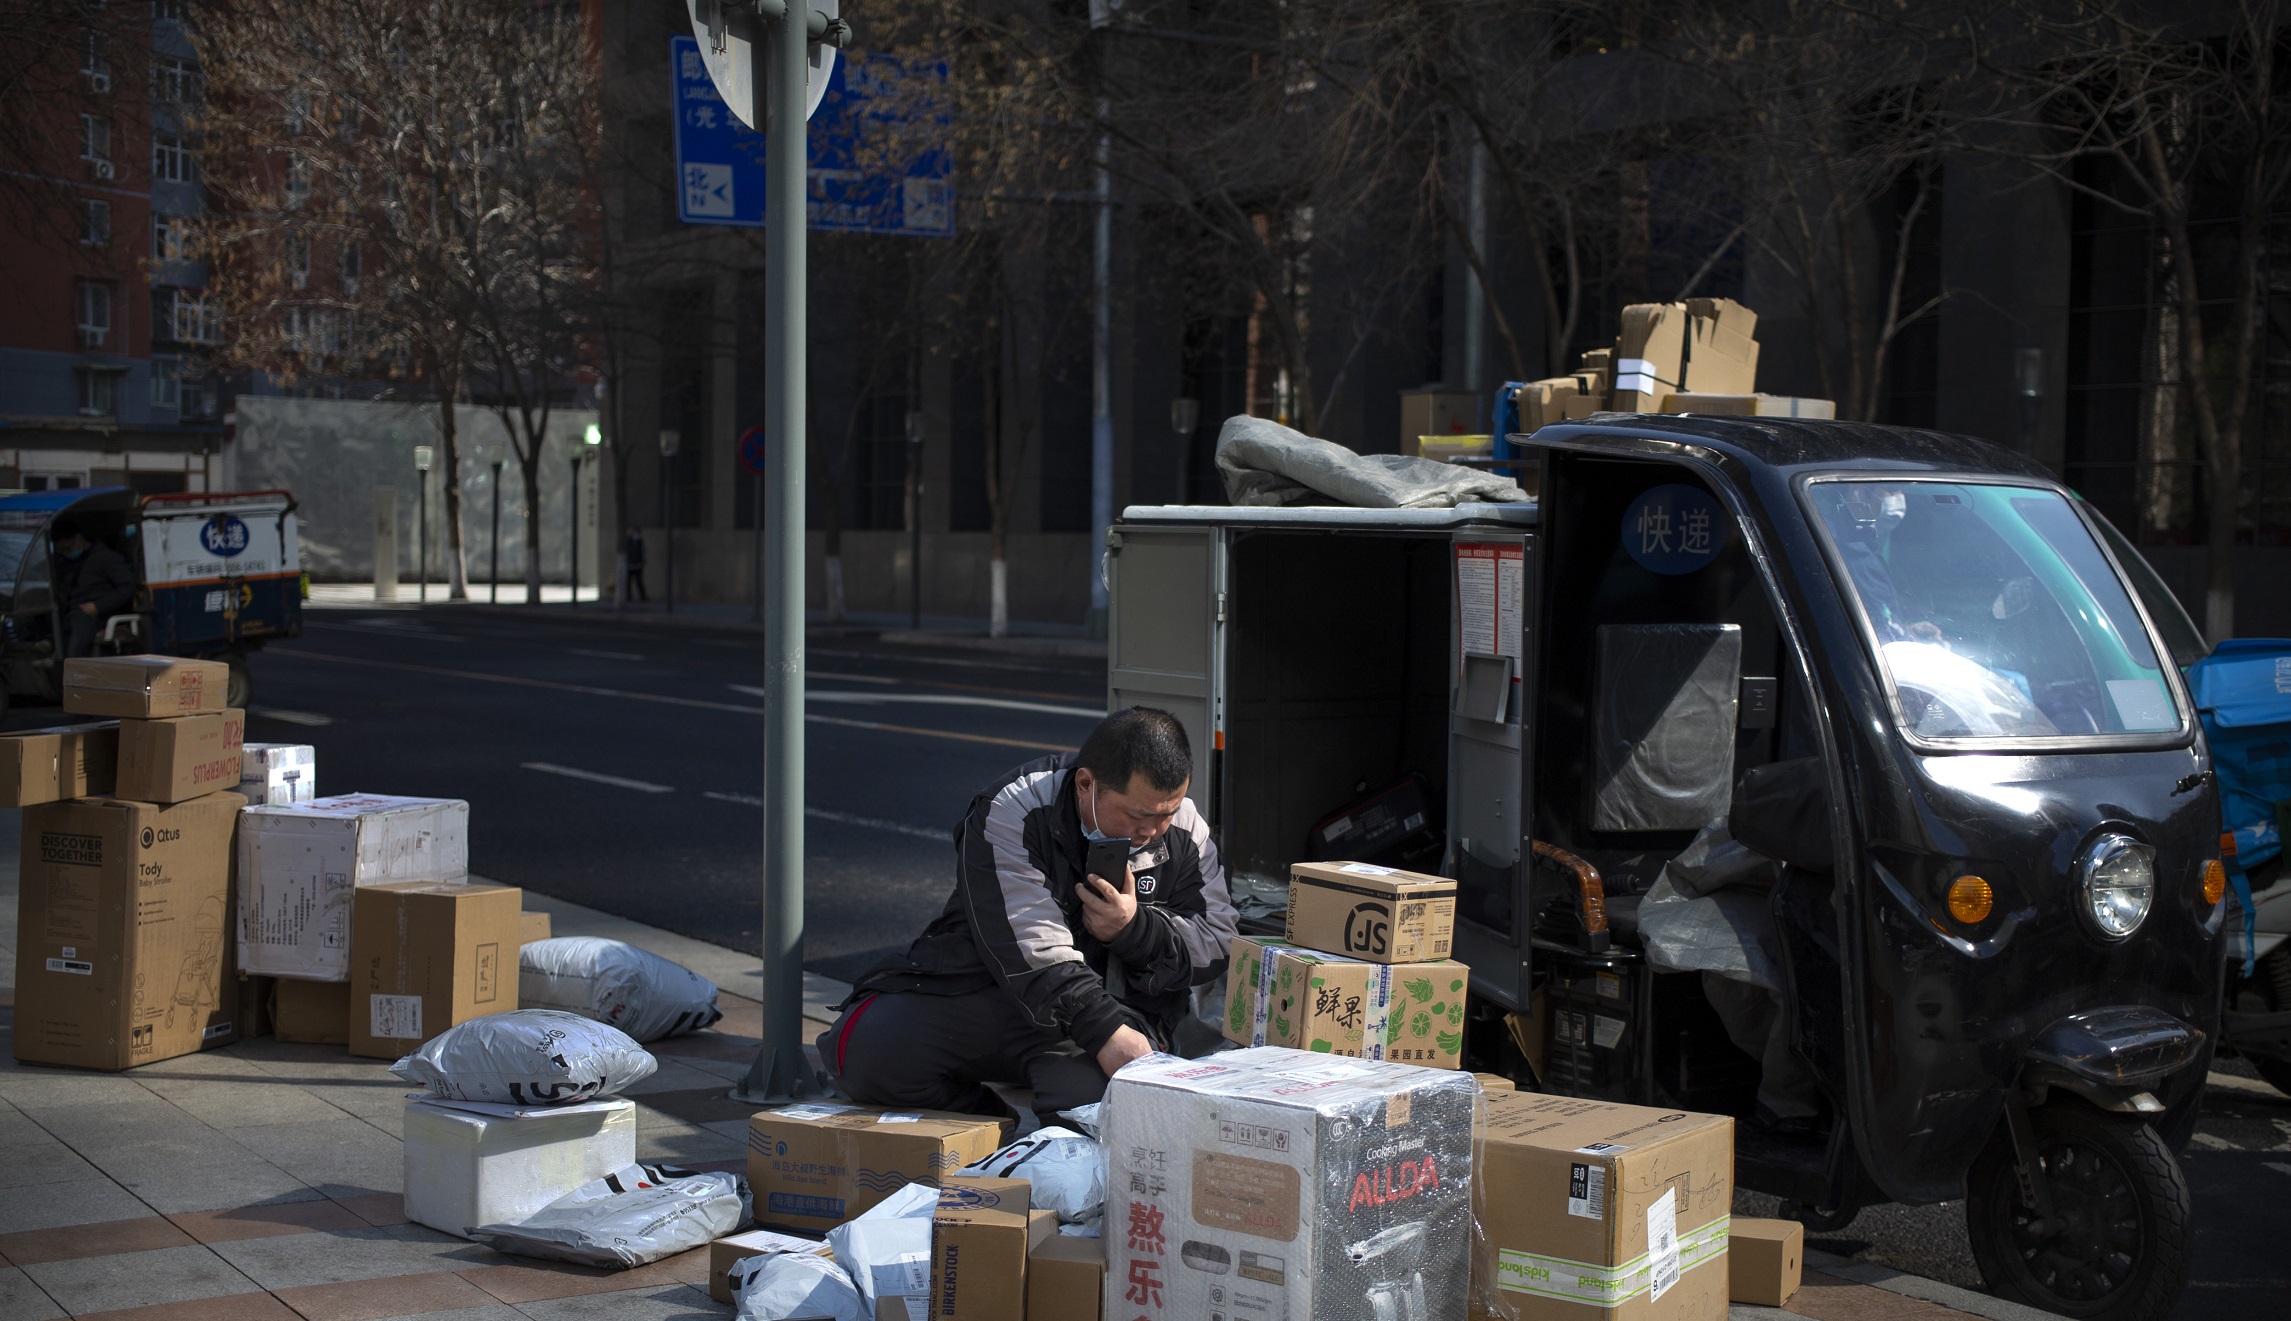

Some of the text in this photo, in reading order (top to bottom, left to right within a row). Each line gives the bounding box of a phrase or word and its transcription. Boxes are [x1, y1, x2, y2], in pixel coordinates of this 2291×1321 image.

[205, 523, 245, 551] 快递
[1637, 505, 1711, 554] 快递
[41, 835, 103, 851] DISCOVER
[156, 827, 180, 843] Qtus
[41, 847, 103, 863] TOGETHER
[139, 862, 163, 878] Tody
[1286, 887, 1298, 941] SF EXPRESS
[1354, 919, 1388, 955] SF
[1314, 986, 1362, 1028] 鲜果
[131, 1046, 153, 1056] FRAGILE
[1390, 1049, 1436, 1060] 果园直发
[1366, 1137, 1425, 1161] Cooking Master
[1129, 1171, 1167, 1197] 高手
[1349, 1155, 1439, 1213] ALLDA
[1125, 1200, 1167, 1321] 熬乐
[942, 1245, 959, 1316] BIRKENSTOCK
